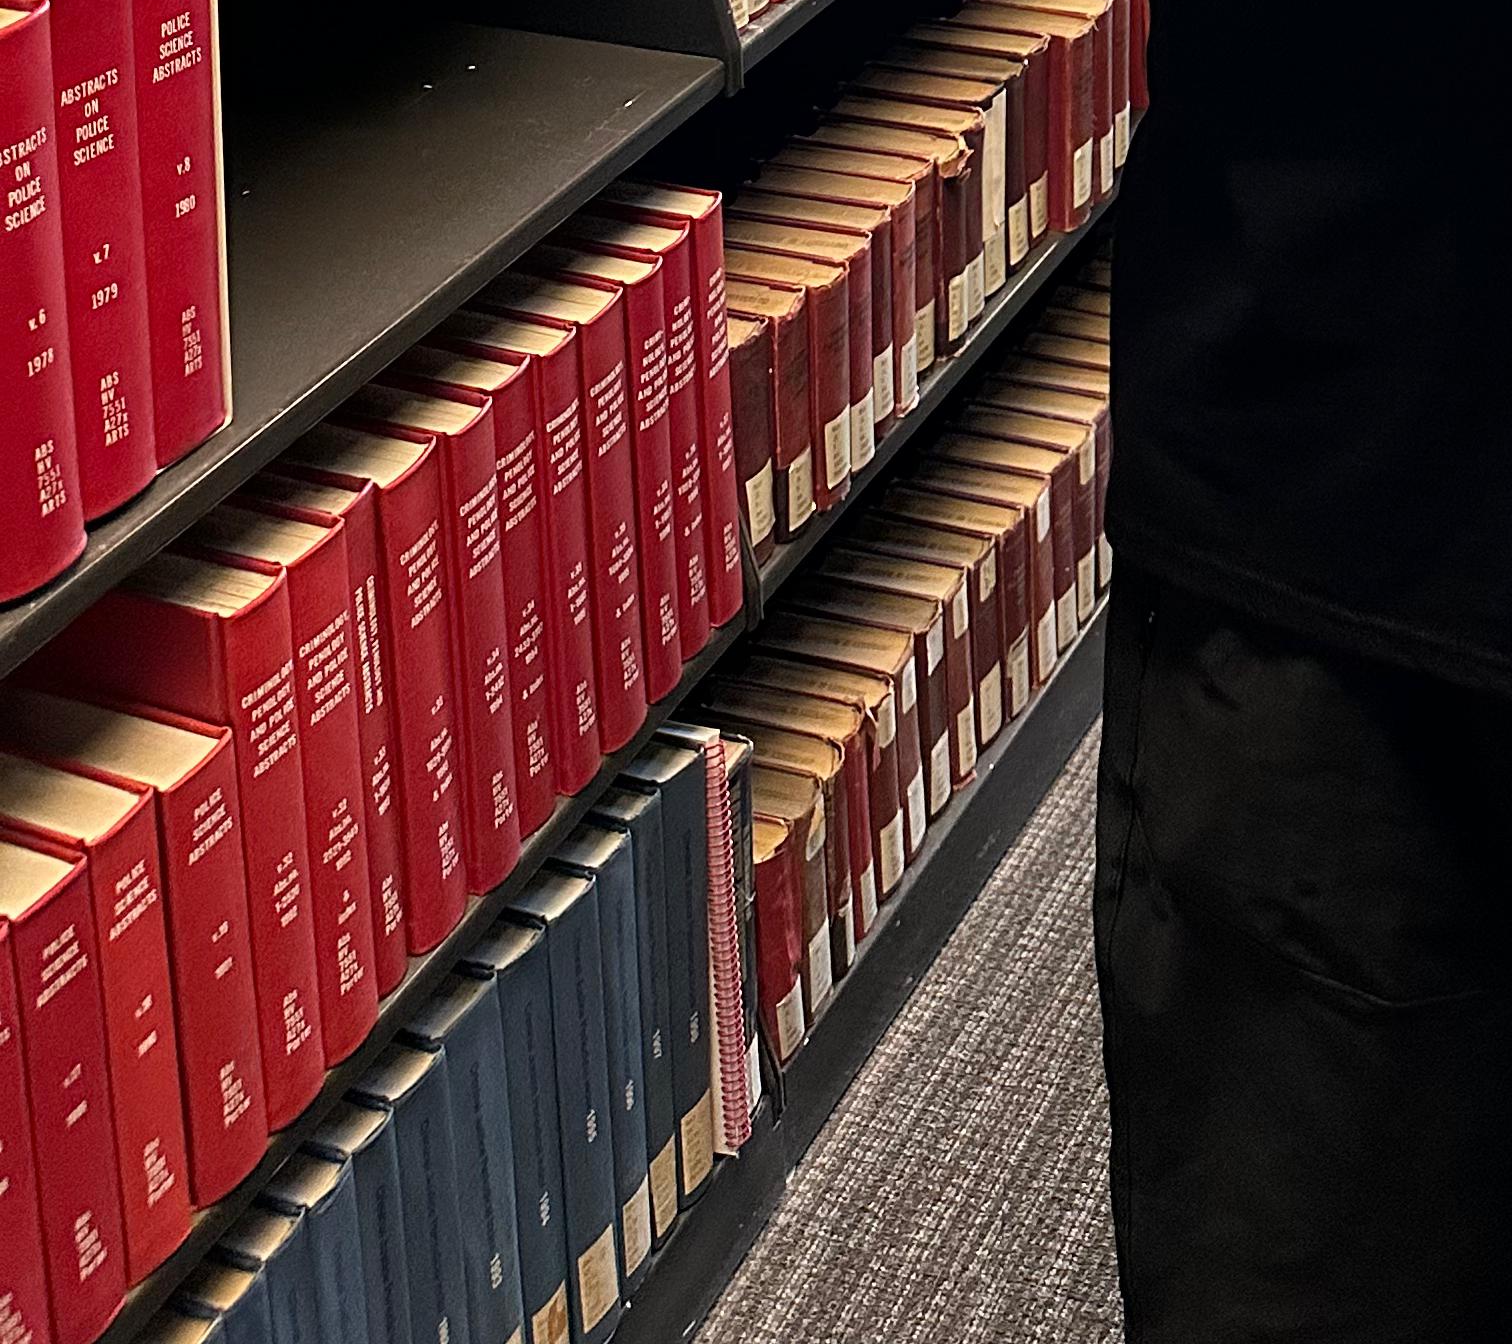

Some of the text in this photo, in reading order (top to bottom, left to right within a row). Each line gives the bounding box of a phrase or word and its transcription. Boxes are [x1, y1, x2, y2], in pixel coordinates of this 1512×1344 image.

[160, 11, 192, 39] POLICE
[159, 29, 195, 61] SCIENCE
[152, 46, 203, 85] ABSTRACTS
[60, 67, 119, 108] ABSTRACTS
[83, 97, 100, 119] ON
[75, 114, 110, 145] POLICE
[73, 133, 116, 168] SCIENCE
[176, 155, 192, 176] v.8
[15, 160, 32, 183] ON
[8, 175, 42, 209] POLICE
[175, 194, 197, 219] 1980
[4, 194, 47, 233] SCIENCE
[91, 282, 119, 311] 1979
[27, 346, 55, 379] 1978
[184, 356, 203, 378] ARTS
[100, 370, 121, 393] ABS
[101, 387, 117, 406] HV
[102, 396, 127, 420] 7551
[34, 438, 55, 462] ABS
[105, 423, 131, 448] ARTS
[41, 491, 68, 519] ARTS
[307, 631, 346, 672] PENOLOGY
[306, 646, 349, 691] AND POLICE
[250, 681, 292, 723] PENOLOGY
[314, 668, 346, 705] SCIENCE
[249, 695, 296, 743] AND POLICE
[309, 682, 351, 727] ABSTRACTS
[257, 719, 291, 757] SCIENCE
[252, 732, 298, 779] ABSTRACTS
